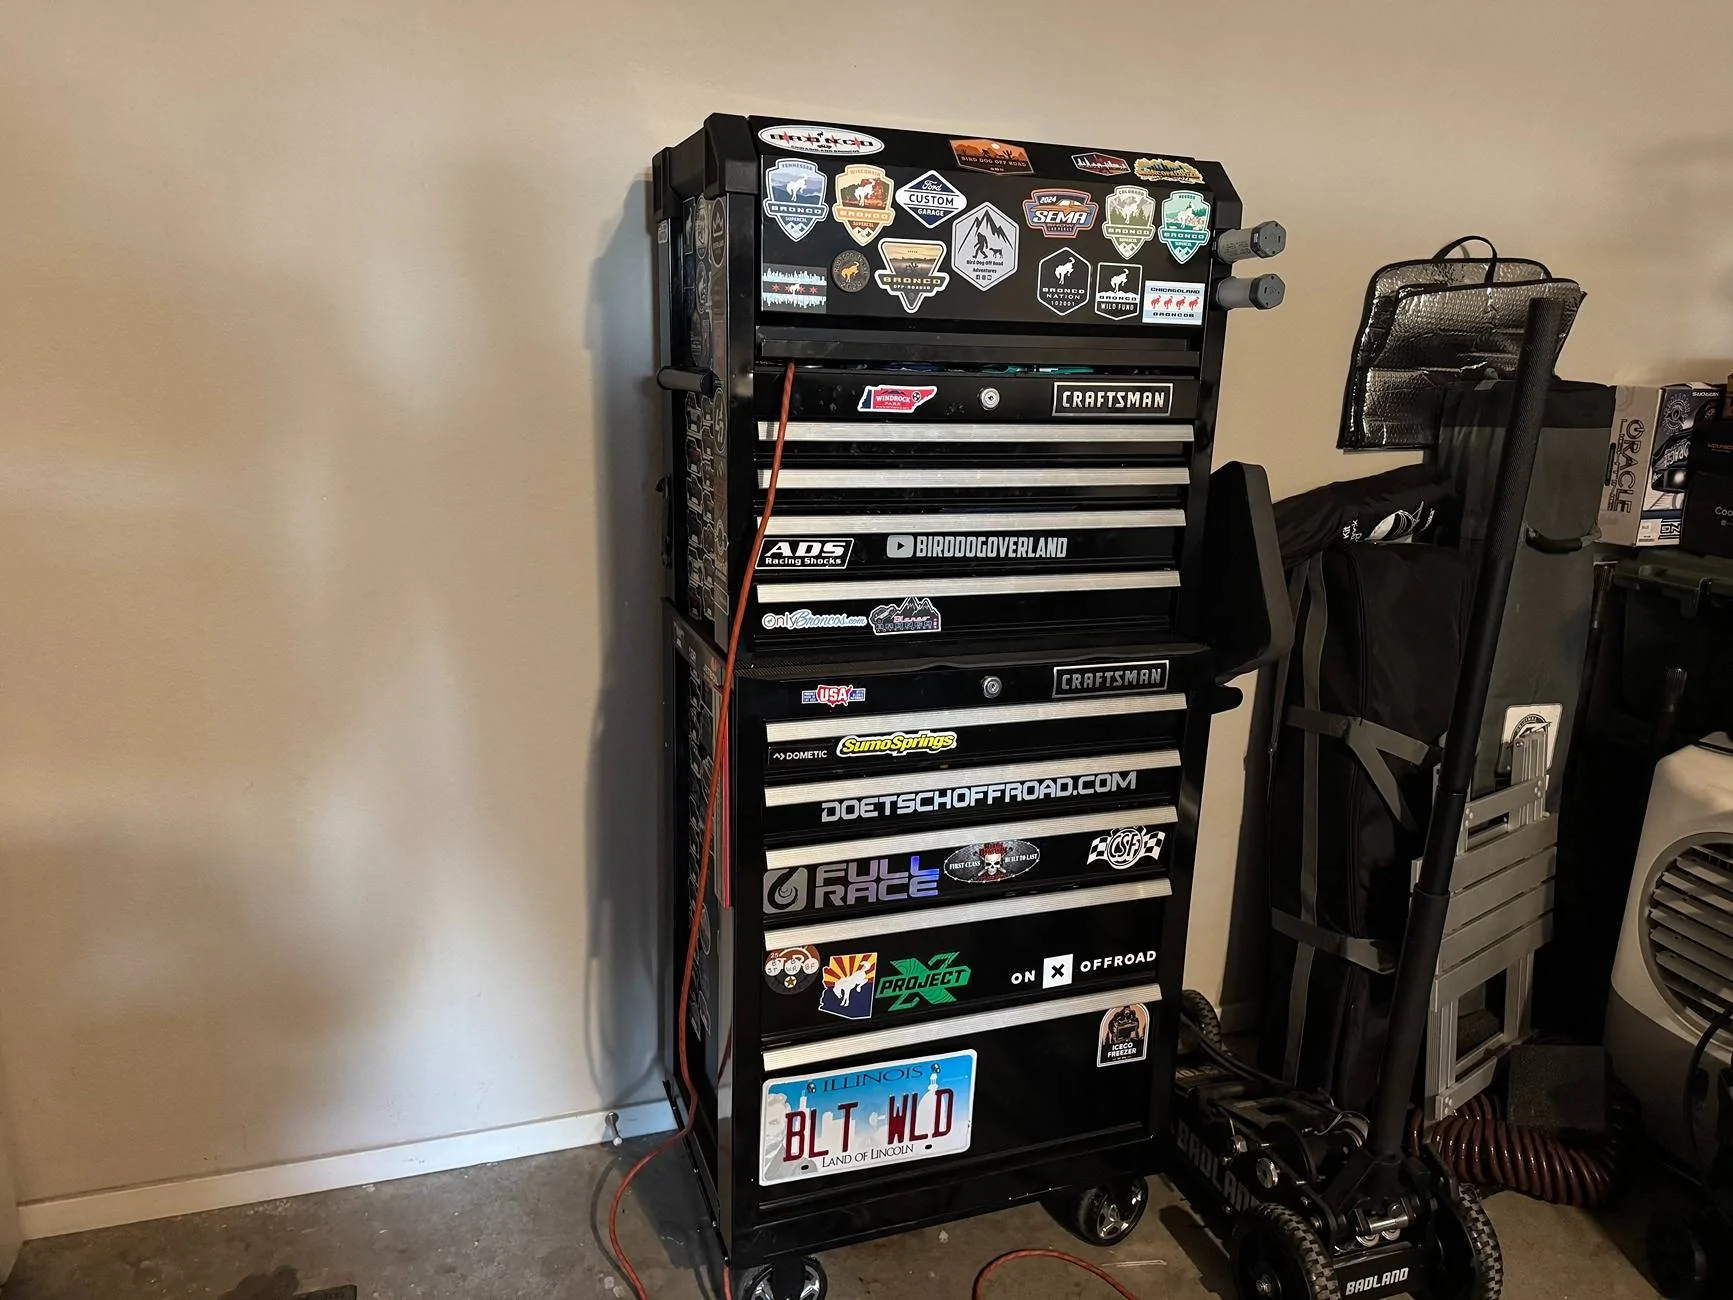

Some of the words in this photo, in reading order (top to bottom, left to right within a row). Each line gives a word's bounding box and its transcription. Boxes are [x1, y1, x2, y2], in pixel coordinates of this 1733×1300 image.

[922, 180, 942, 192] Ford
[909, 193, 954, 206] CUSTOM
[1040, 196, 1057, 204] 2024
[771, 205, 822, 215] BRONCO
[839, 210, 889, 220] BRONCO
[917, 208, 945, 217] GARAGE
[1033, 210, 1088, 224] SEMA
[1107, 227, 1150, 235] BRONCO
[1164, 231, 1205, 240] BRONCO
[883, 276, 941, 286] BRONCO
[1101, 303, 1116, 311] WILD
[1118, 303, 1134, 311] FUND
[875, 395, 911, 403] WINDROCK
[1062, 391, 1165, 408] CRAFTSMAN
[1615, 419, 1645, 514] ORACLE
[764, 542, 846, 557] ADS
[916, 536, 1068, 558] BIRDDOGOVERLAND
[765, 557, 801, 566] Racing
[804, 557, 841, 565] Shocks
[762, 609, 867, 629] OnlyBroncos.com
[1061, 668, 1161, 690] CRAFTSMAN
[820, 688, 848, 701] USA
[842, 734, 955, 753] SumoSprings
[786, 750, 828, 760] DOMETIC
[821, 771, 1137, 823] DOETSCHOFFROAD.COM
[1109, 831, 1141, 859] CSF
[1004, 855, 1019, 863] BUILT
[1026, 853, 1038, 861] LAST
[815, 855, 940, 887] FULL
[949, 861, 965, 870] FIRST
[965, 860, 981, 868] CLASS
[814, 874, 940, 909] RACE
[1011, 970, 1026, 985] ON
[1080, 951, 1157, 973] OFFROAD
[880, 969, 968, 993] PROJECT
[1107, 1048, 1137, 1058] FREEZER
[1112, 1042, 1134, 1051] ICECO
[823, 1065, 923, 1093] ILLINOIS
[887, 1088, 954, 1145] WLD
[822, 1154, 852, 1168] LAND
[855, 1151, 869, 1162] OF
[870, 1144, 914, 1160] LINCOLN
[1345, 1267, 1409, 1296] BADLAND
